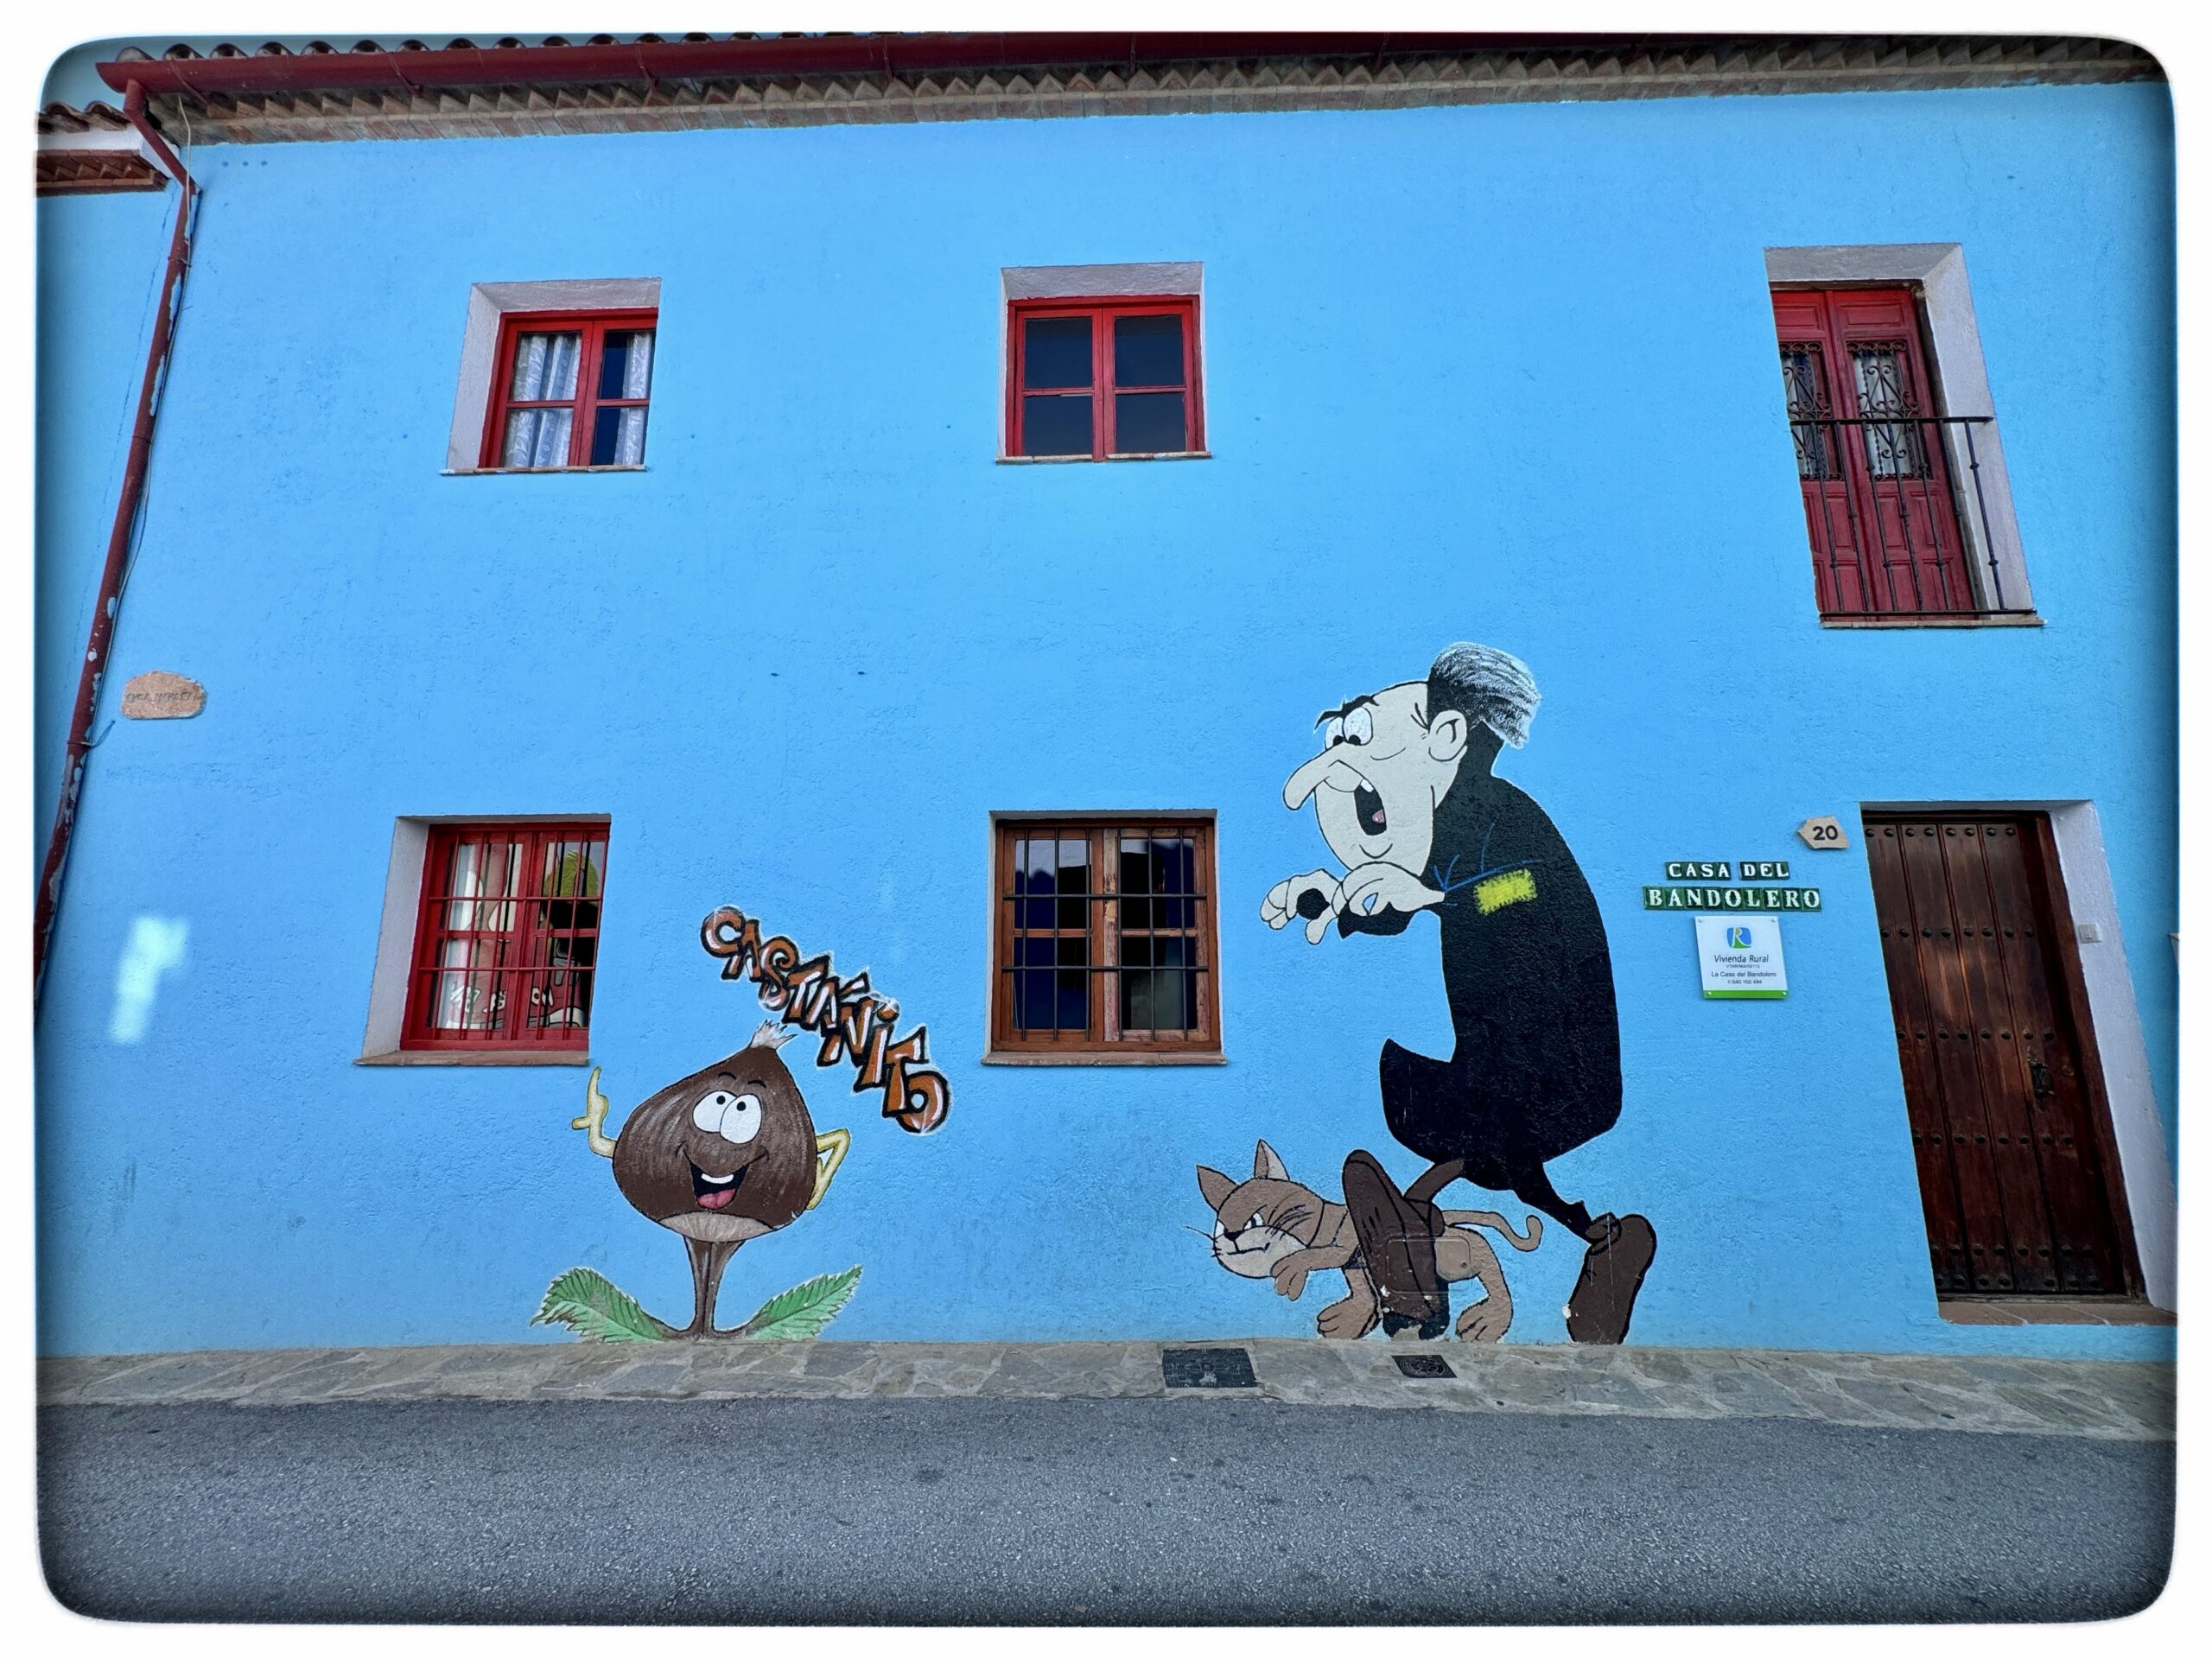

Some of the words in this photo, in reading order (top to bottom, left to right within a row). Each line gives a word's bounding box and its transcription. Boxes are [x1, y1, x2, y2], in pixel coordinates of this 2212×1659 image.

[1812, 824, 1839, 841] 20
[1669, 863, 1730, 878] CASA
[1744, 863, 1789, 878] DEL
[1648, 889, 1820, 908] BANDOLERO
[1714, 954, 1746, 963] Vivienda
[1749, 954, 1769, 963] Rural
